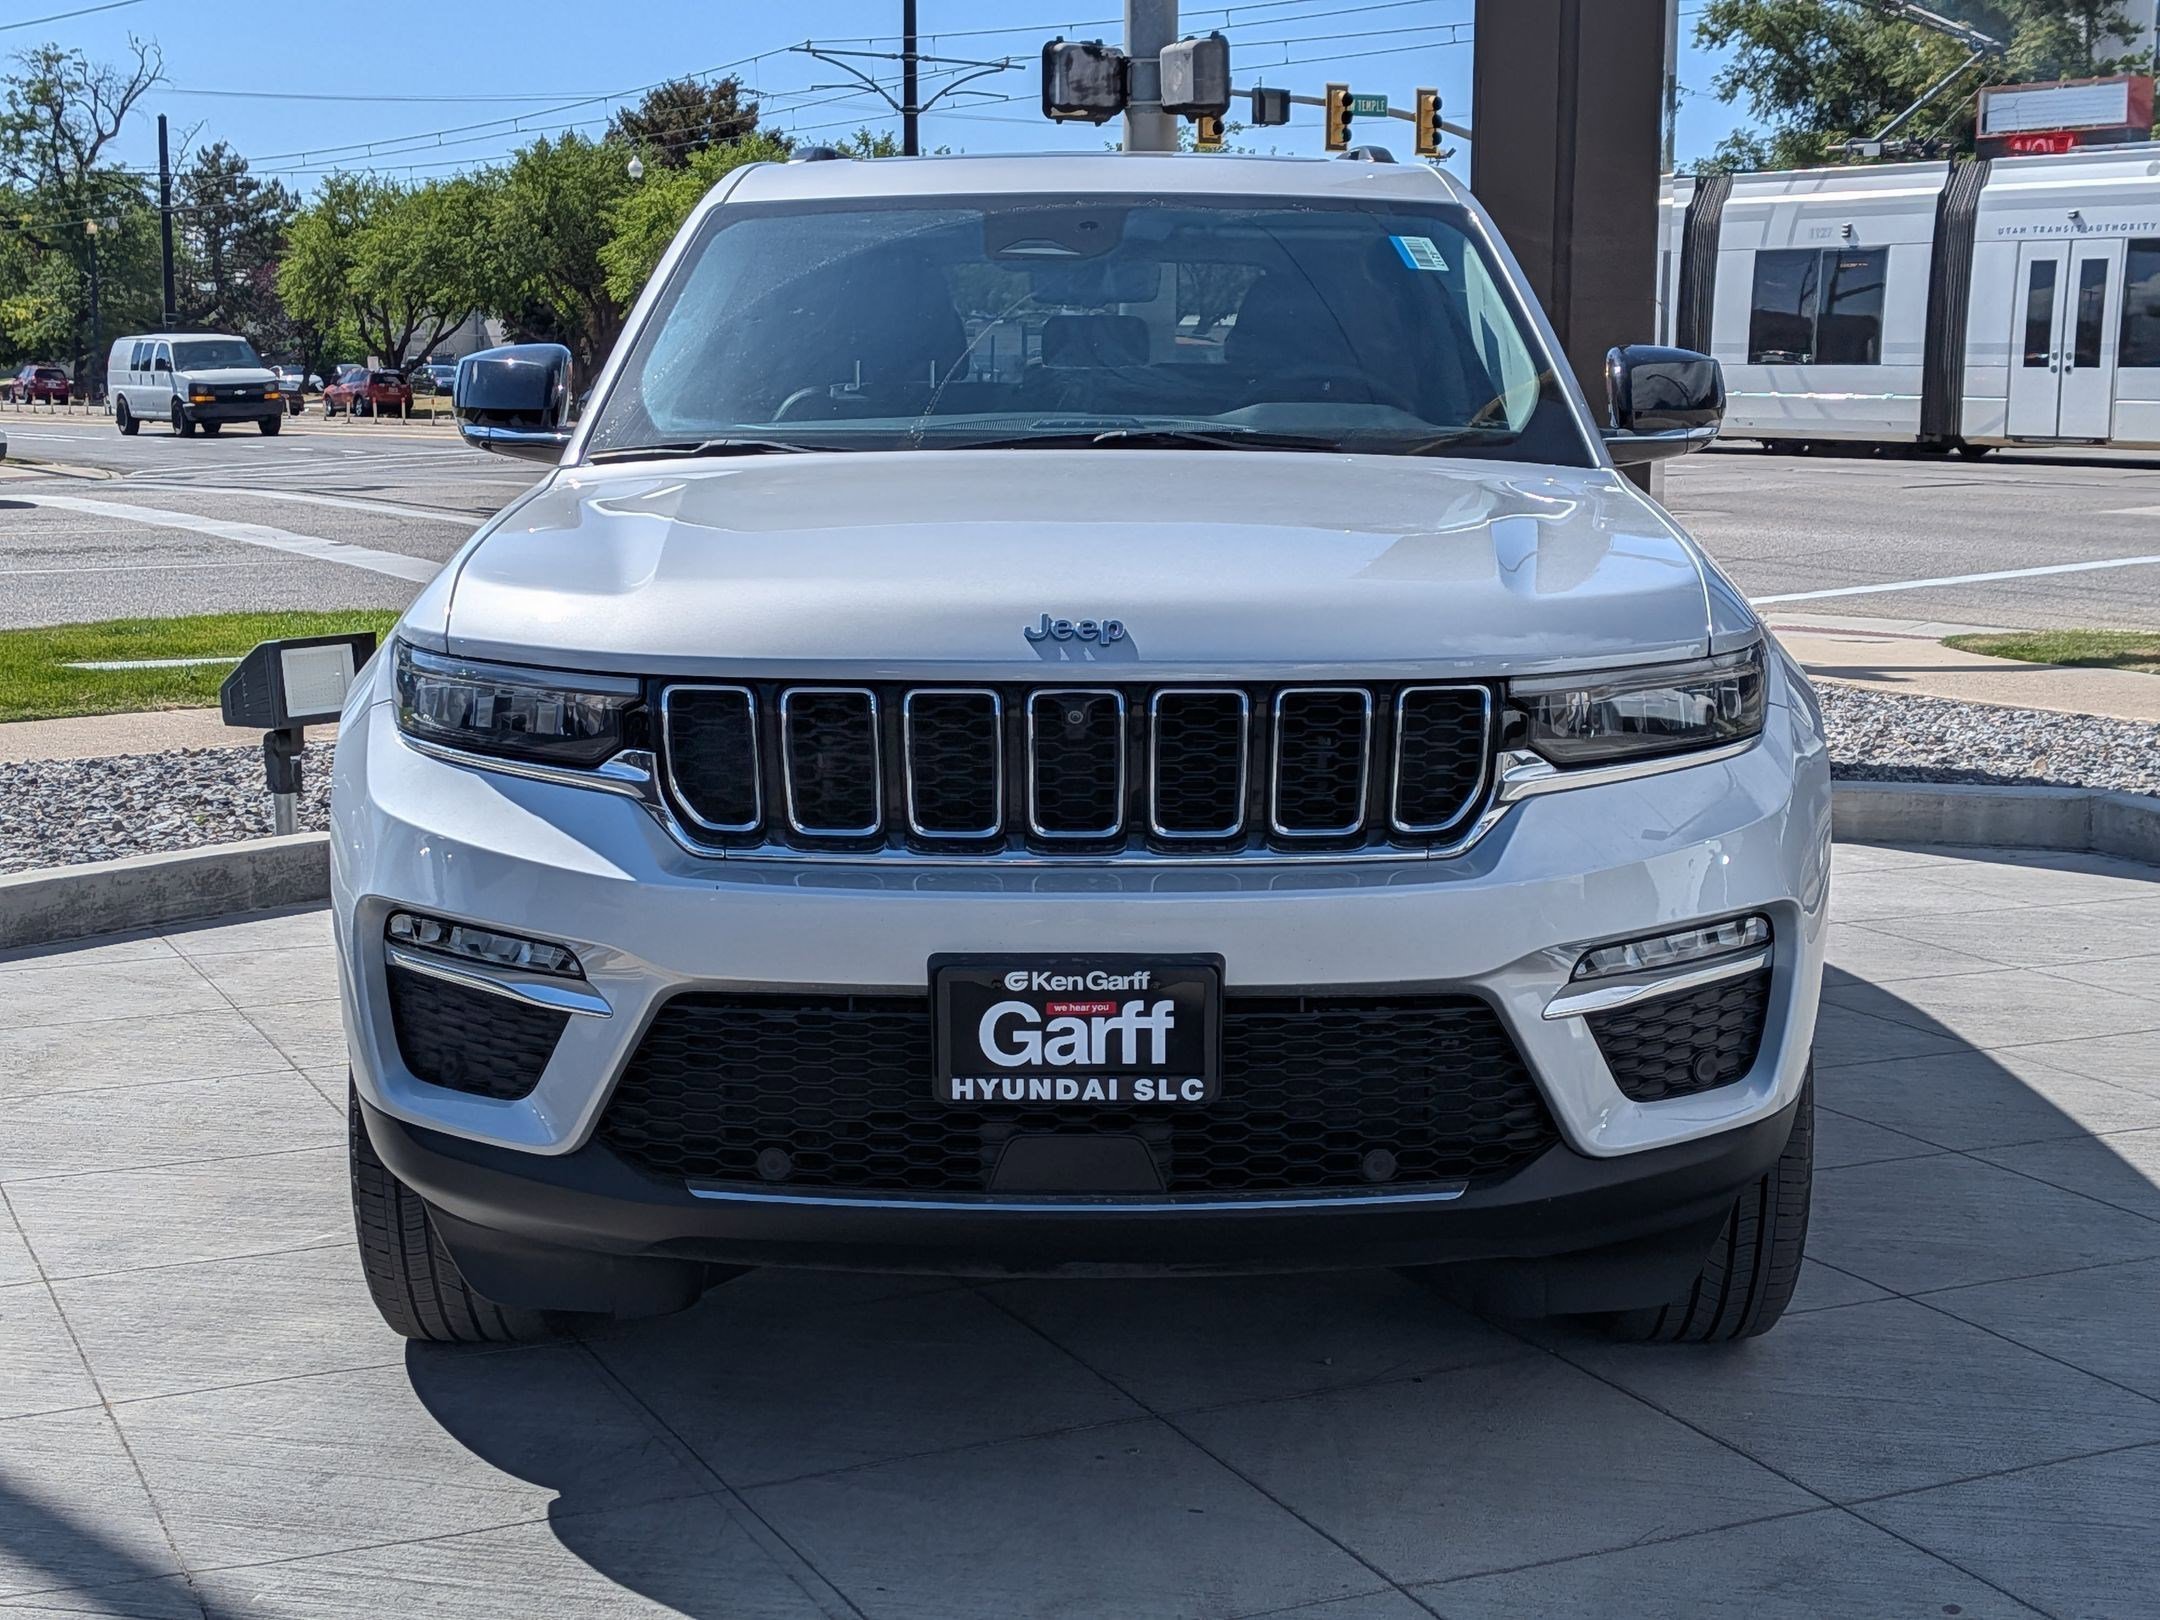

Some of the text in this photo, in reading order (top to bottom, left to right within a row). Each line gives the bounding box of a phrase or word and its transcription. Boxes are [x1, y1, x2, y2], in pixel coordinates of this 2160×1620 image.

[1357, 99, 1385, 112] TEMPLE
[1998, 222, 2158, 235] UTAH TRANSIT AUTHORITY
[1023, 612, 1125, 646] Jeep
[1032, 971, 1151, 991] Ken Garff
[1069, 1003, 1090, 1012] hear
[1091, 1004, 1110, 1013] you
[978, 999, 1175, 1067] Garff
[951, 1078, 1204, 1101] HYUNDAI SLC
